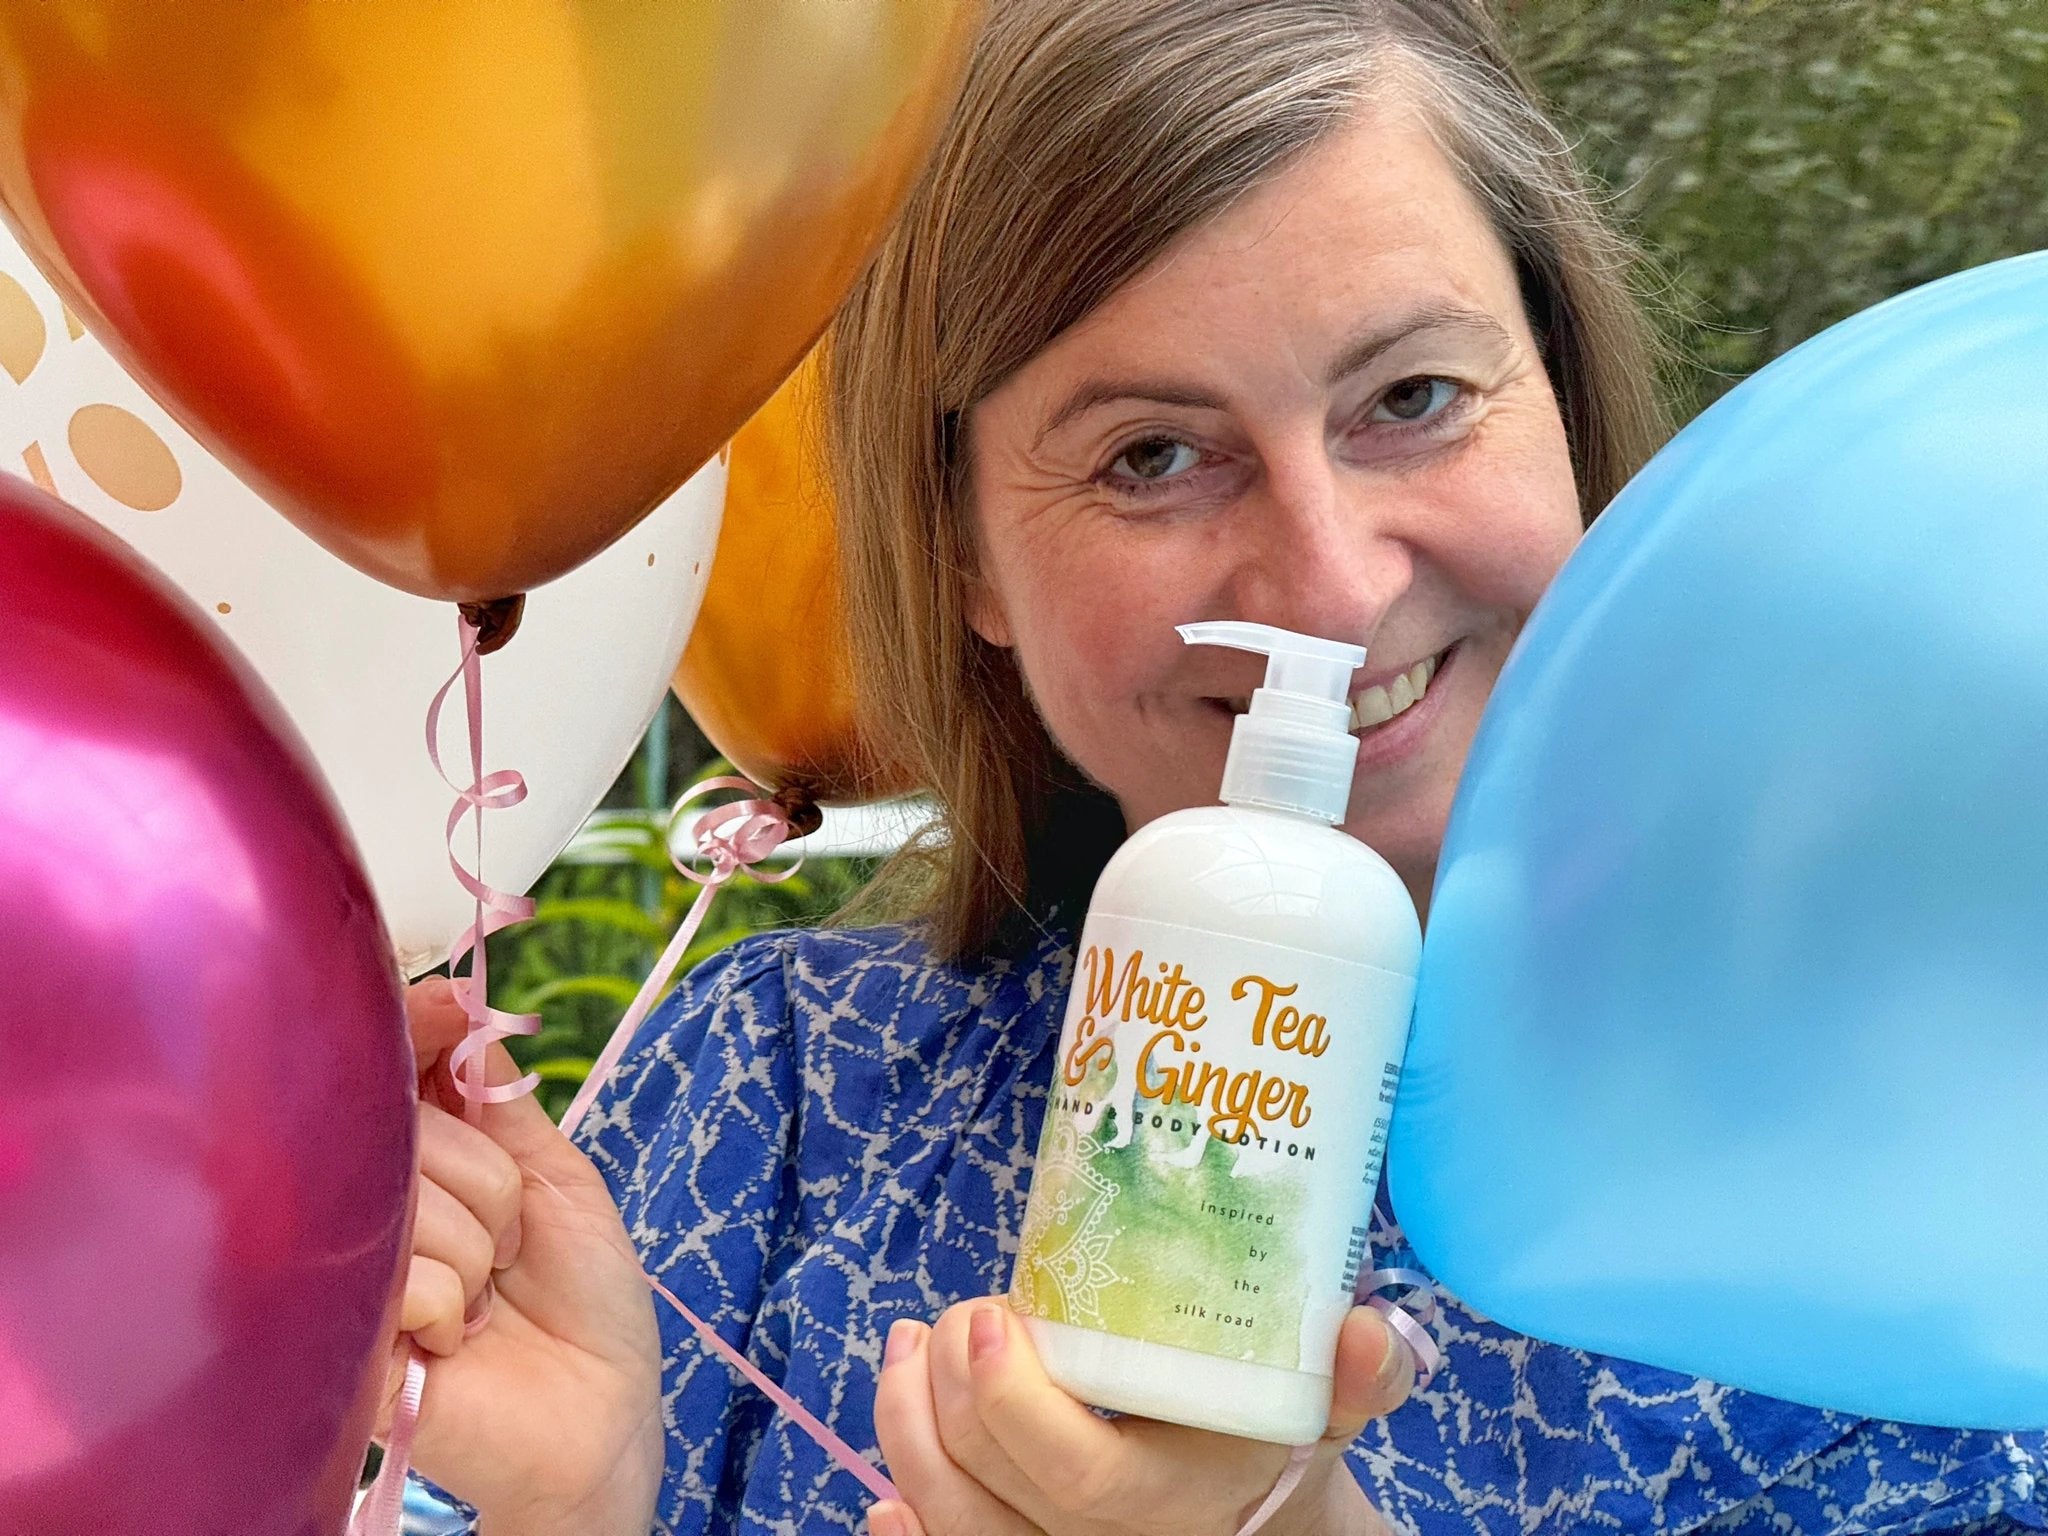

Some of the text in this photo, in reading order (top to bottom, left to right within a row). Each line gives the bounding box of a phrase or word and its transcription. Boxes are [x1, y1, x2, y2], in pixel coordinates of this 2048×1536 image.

[1083, 945, 1331, 1057] White Tea
[1064, 1015, 1312, 1145] & Ginger
[1133, 1111, 1201, 1136] BODY
[1221, 1128, 1316, 1161] LOTION
[1200, 1200, 1275, 1226] inspired
[1248, 1245, 1268, 1262] by
[1234, 1279, 1260, 1294] the
[1174, 1303, 1254, 1328] silk road
